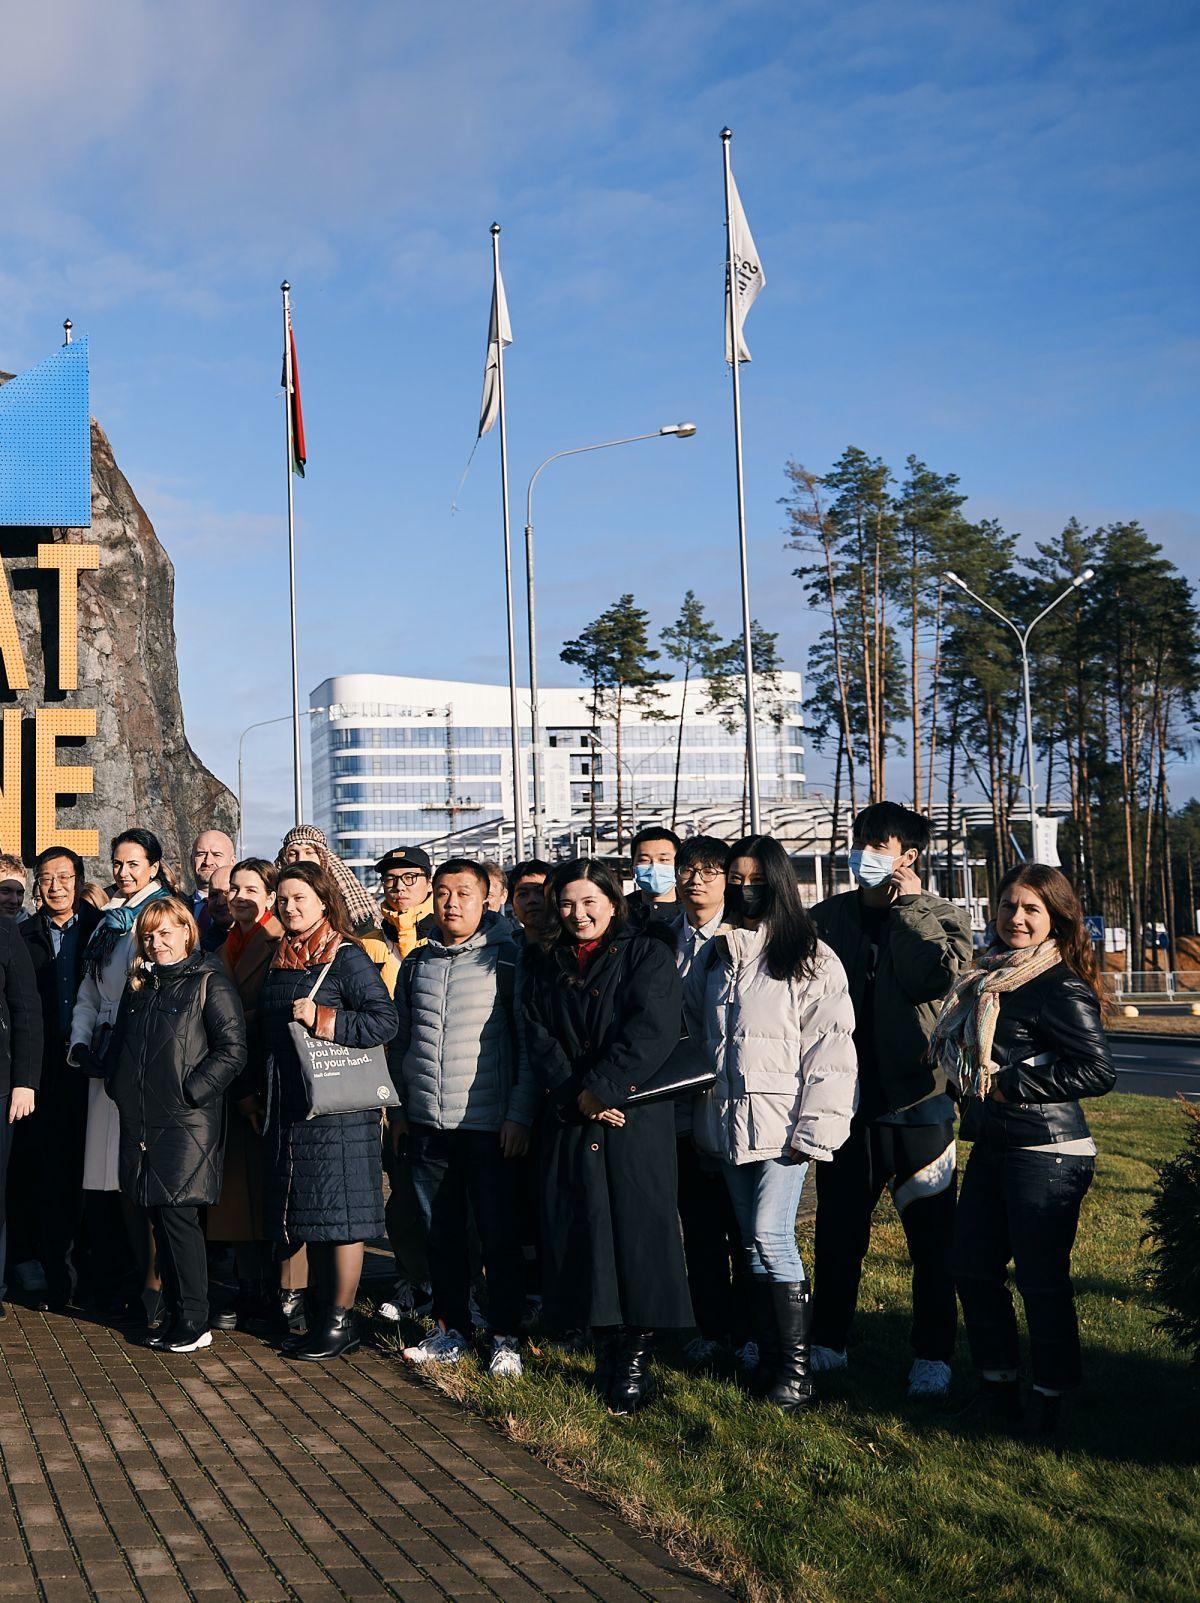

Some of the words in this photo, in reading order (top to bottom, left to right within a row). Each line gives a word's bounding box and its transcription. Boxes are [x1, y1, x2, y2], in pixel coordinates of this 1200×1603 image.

[309, 1050, 328, 1060] you
[329, 1047, 349, 1056] hold
[311, 1059, 323, 1070] in
[324, 1059, 346, 1070] your
[347, 1053, 372, 1066] hand.
